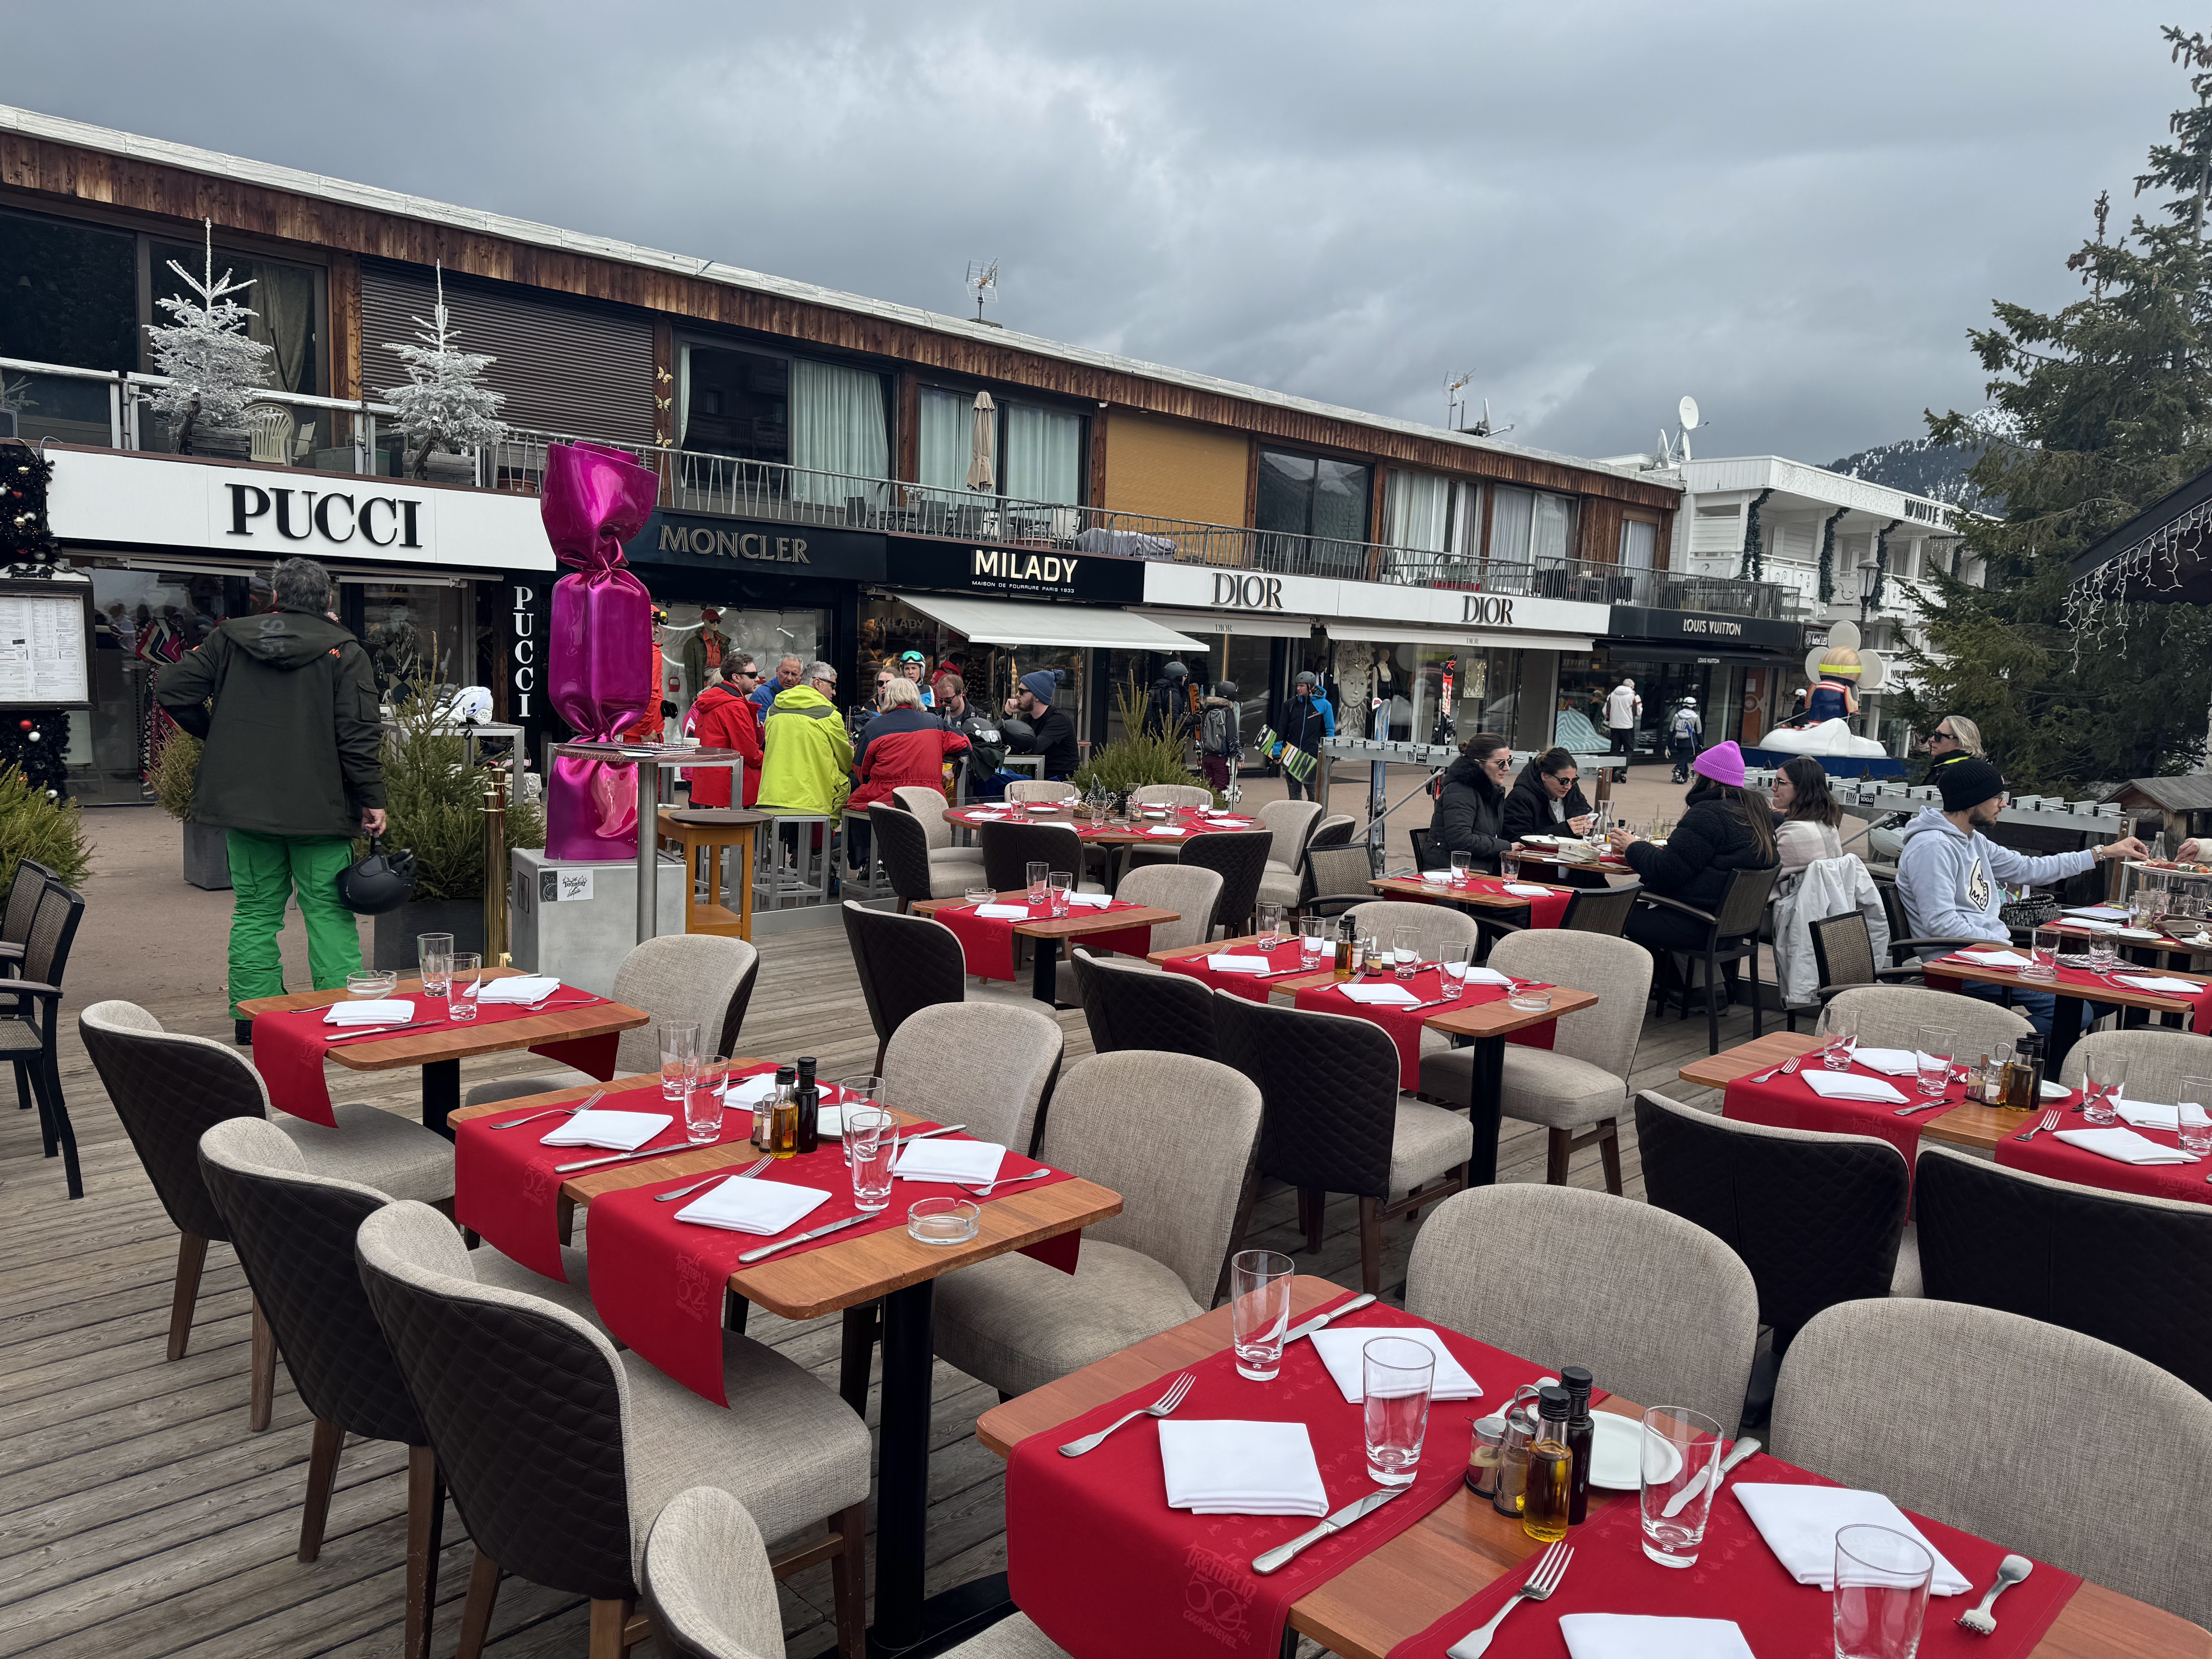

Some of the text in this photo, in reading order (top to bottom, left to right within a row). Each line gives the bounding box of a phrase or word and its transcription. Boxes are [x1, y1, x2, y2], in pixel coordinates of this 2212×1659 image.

[225, 483, 423, 548] PUCCI
[1905, 498, 1941, 524] WHITE
[658, 524, 811, 564] MONCLER
[970, 550, 1078, 583] MILADY
[1211, 572, 1284, 610] DIOR
[1215, 624, 1232, 632] DIOR
[1461, 595, 1513, 626] DIOR
[1683, 619, 1741, 636] LOUIS VUITTON
[513, 586, 534, 717] PUCCI
[1183, 1609, 1237, 1650] COURCHEVEL
